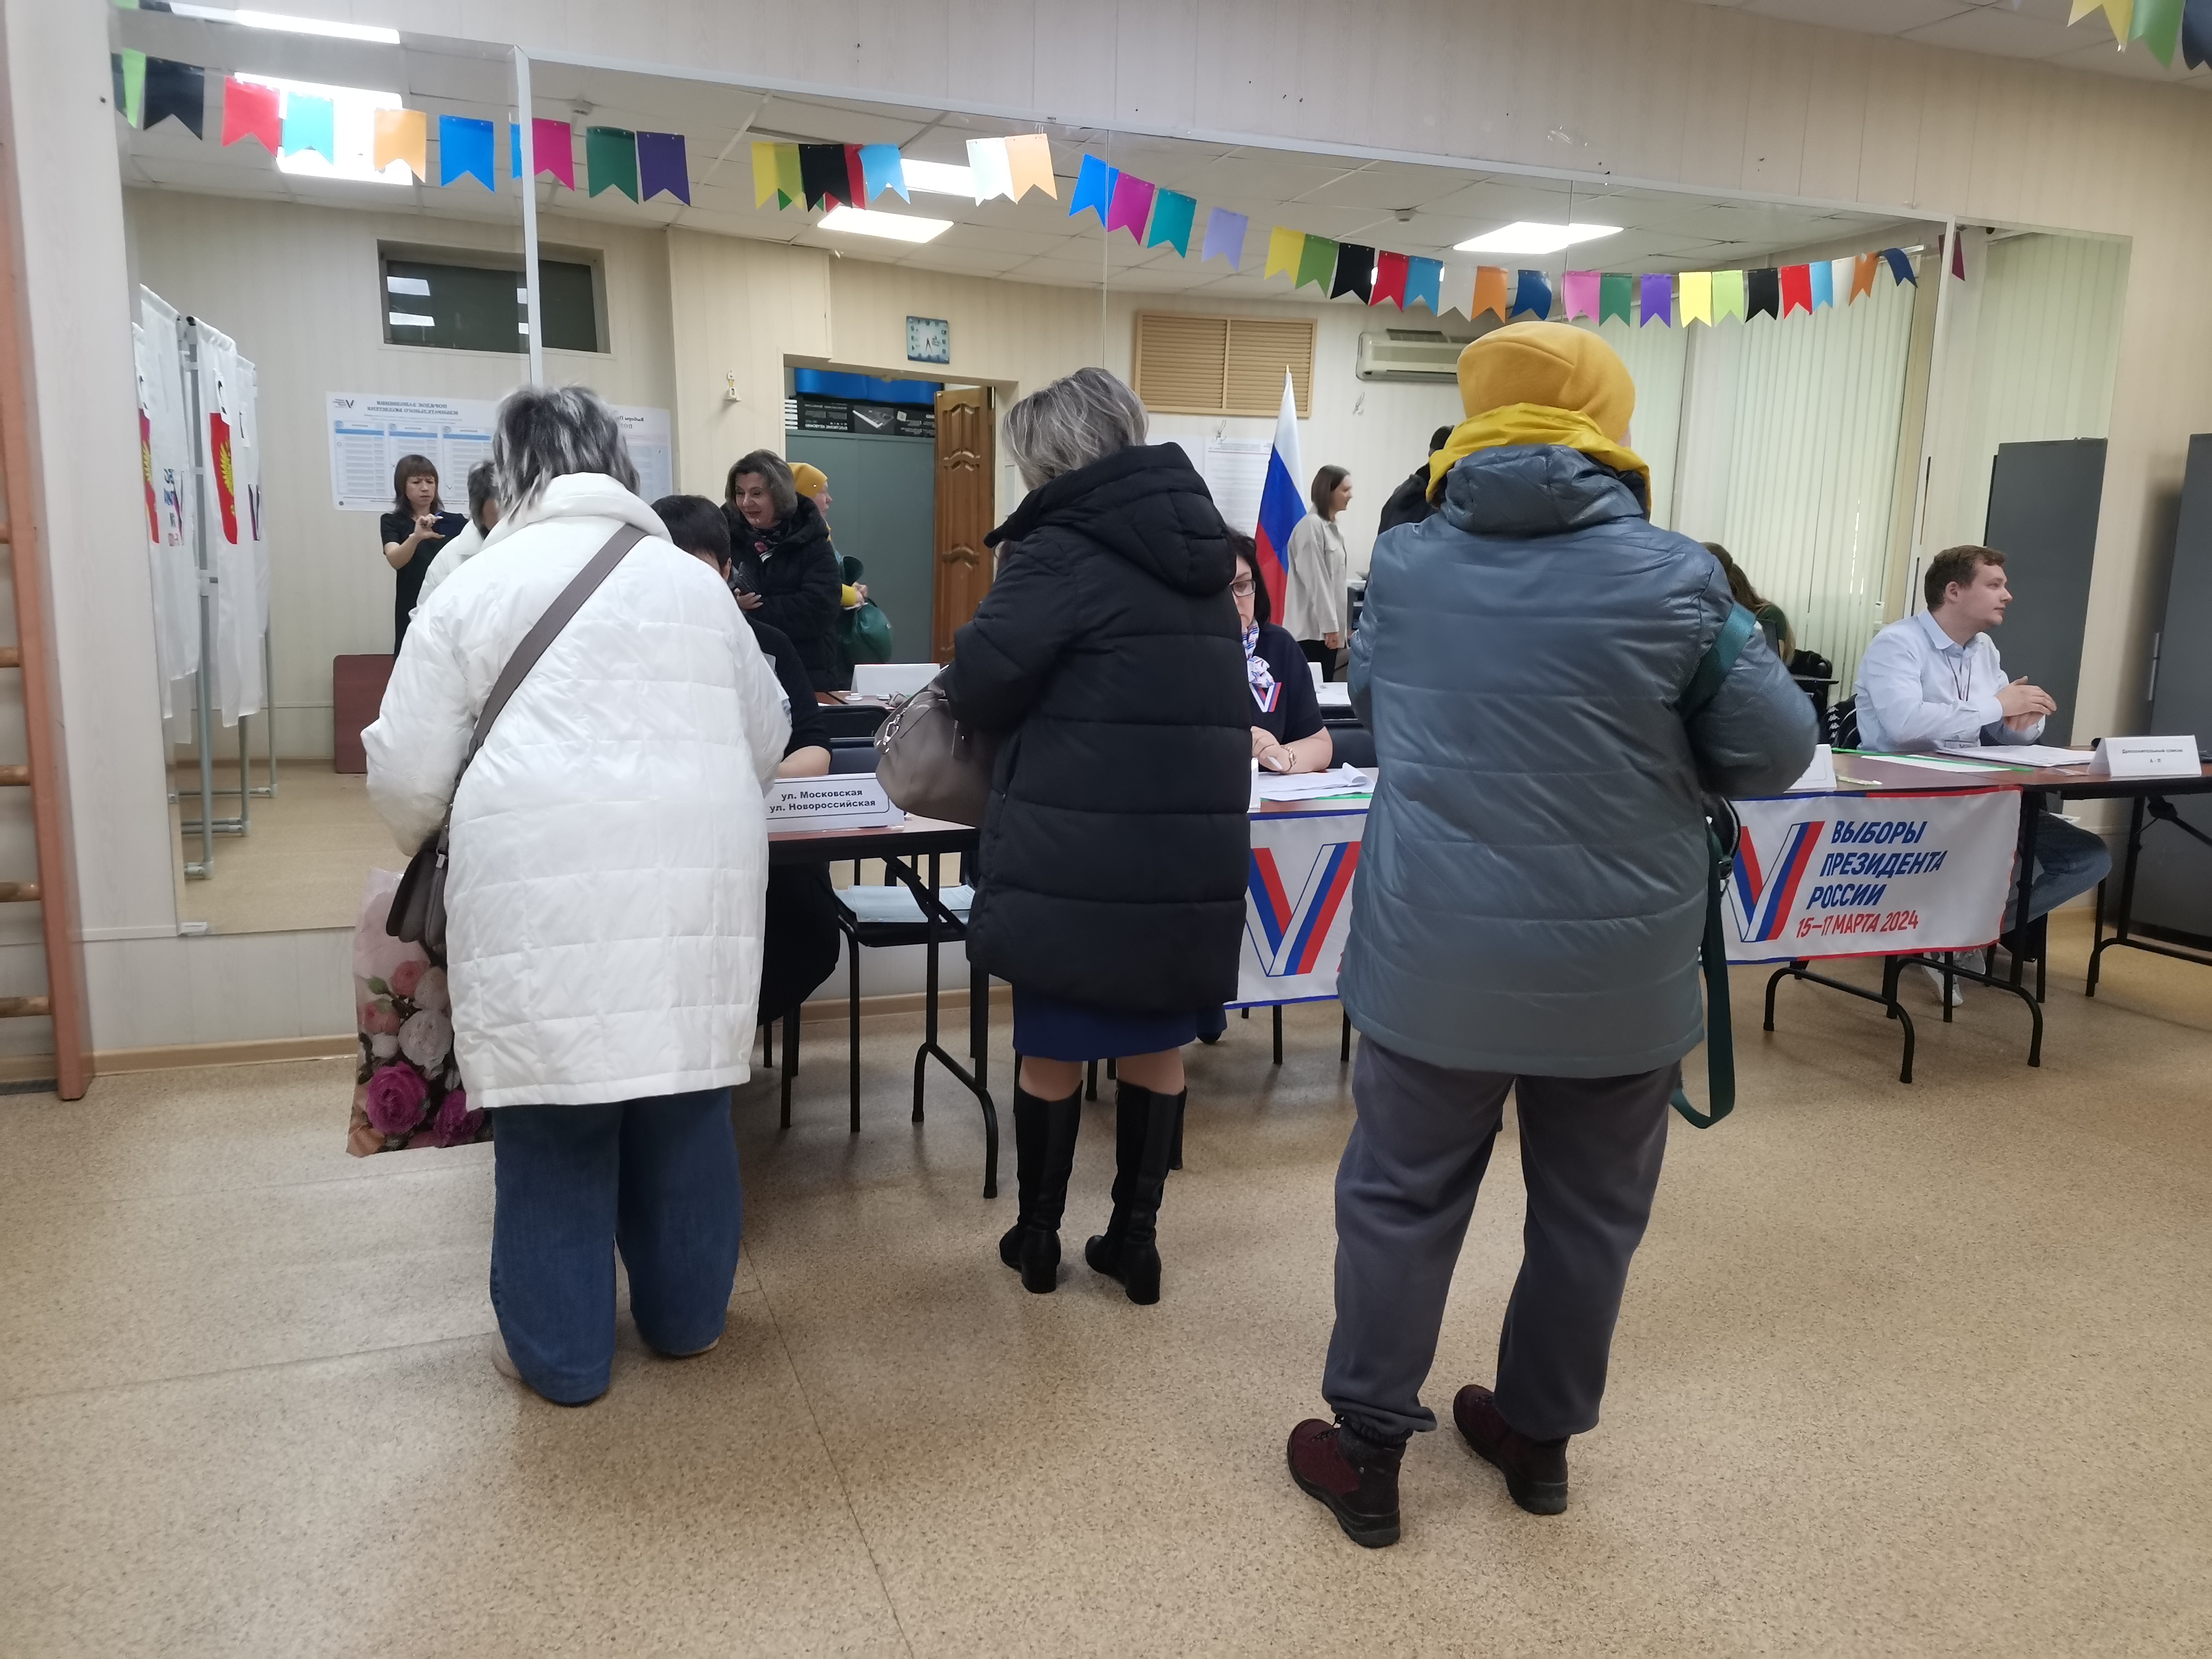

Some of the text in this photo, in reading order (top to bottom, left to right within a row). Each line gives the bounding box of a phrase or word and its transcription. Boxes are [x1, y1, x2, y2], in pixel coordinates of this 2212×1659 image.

[769, 800, 875, 813] ул. Новороссийская
[781, 790, 863, 801] ул. Московская
[1831, 820, 1928, 844] ВЫБОРЫ
[1819, 851, 1948, 878] ПРЕЗИДЕНТА
[1806, 884, 1887, 910] РОССИИ
[1832, 914, 1881, 935] МАРТА
[1880, 910, 1919, 932] 2024
